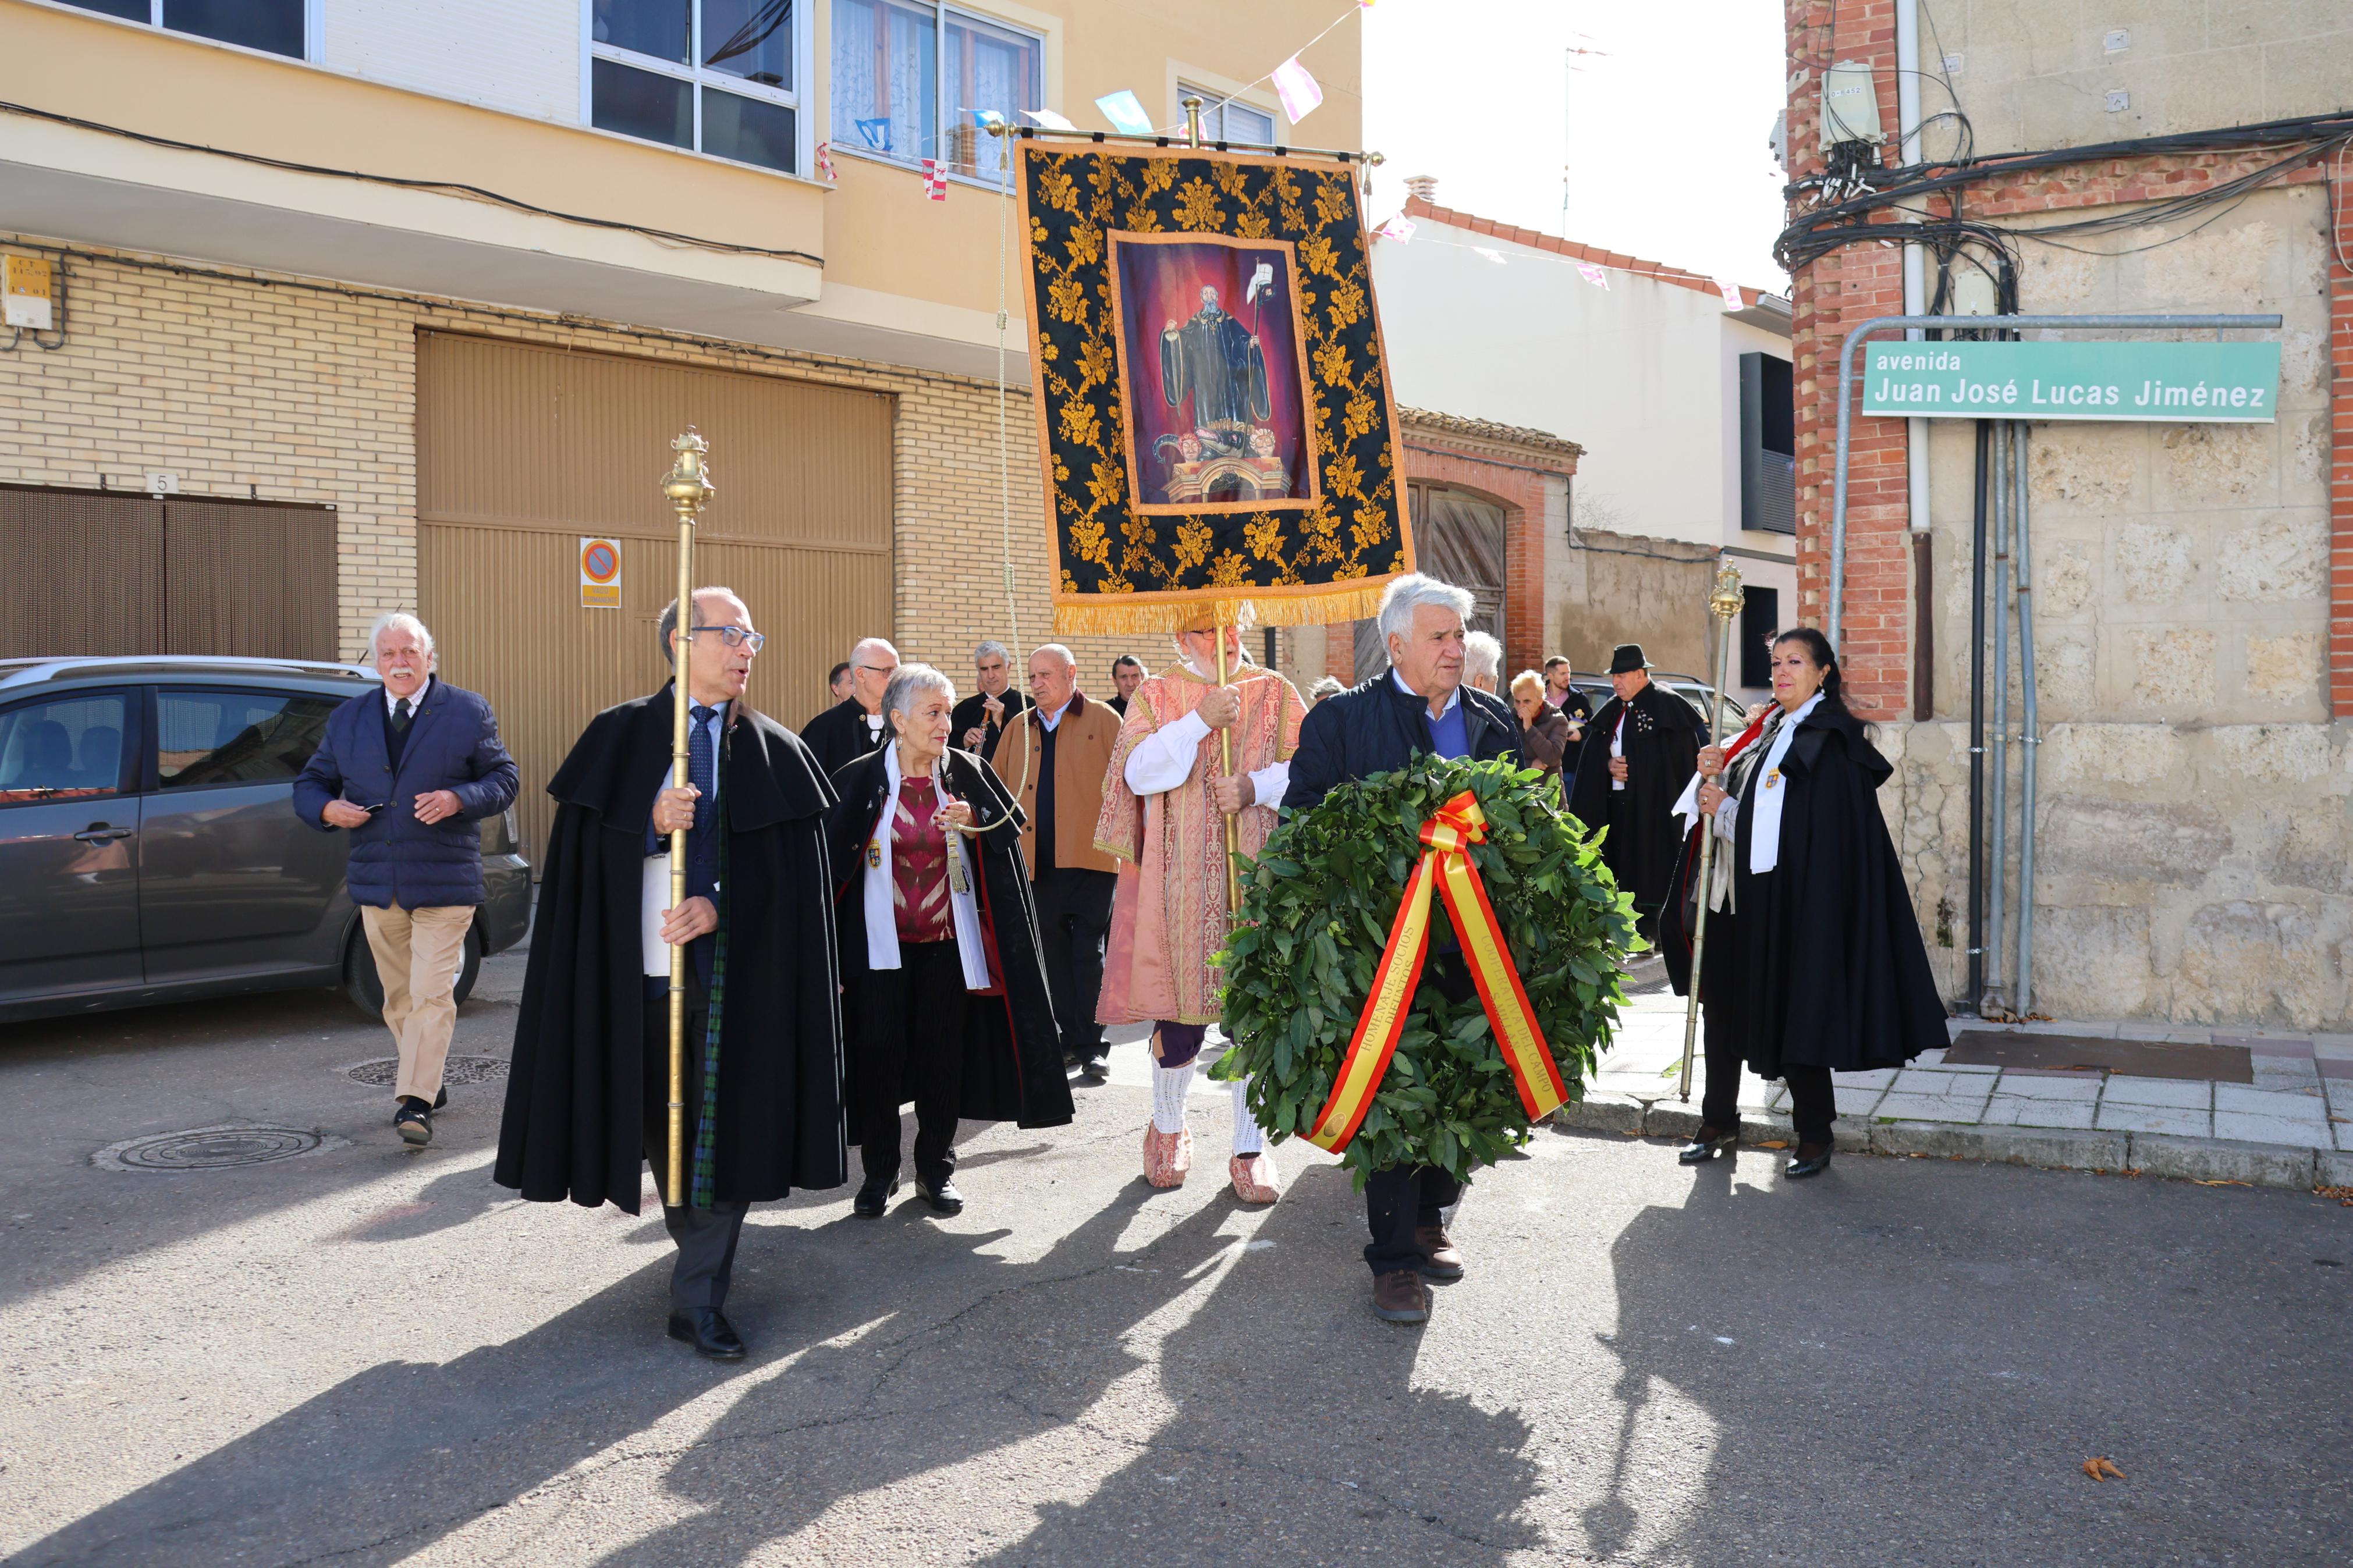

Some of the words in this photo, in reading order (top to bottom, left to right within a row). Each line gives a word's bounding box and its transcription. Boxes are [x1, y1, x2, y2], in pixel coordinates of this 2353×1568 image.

[1876, 351, 1961, 371] avenida
[1875, 378, 1940, 403] Juan
[1951, 379, 2018, 404] José
[2032, 379, 2119, 406] Lucas
[2135, 381, 2265, 407] Jiménez
[157, 475, 167, 491] 5
[1361, 977, 1396, 1052] HOMENAJE
[1389, 926, 1414, 975] SOCIOS
[1385, 960, 1415, 1026] DIFUNTOS
[1481, 935, 1524, 1026] COOPERATIVA
[1517, 1026, 1533, 1052] DEL
[1528, 1052, 1553, 1093] CAMPO
